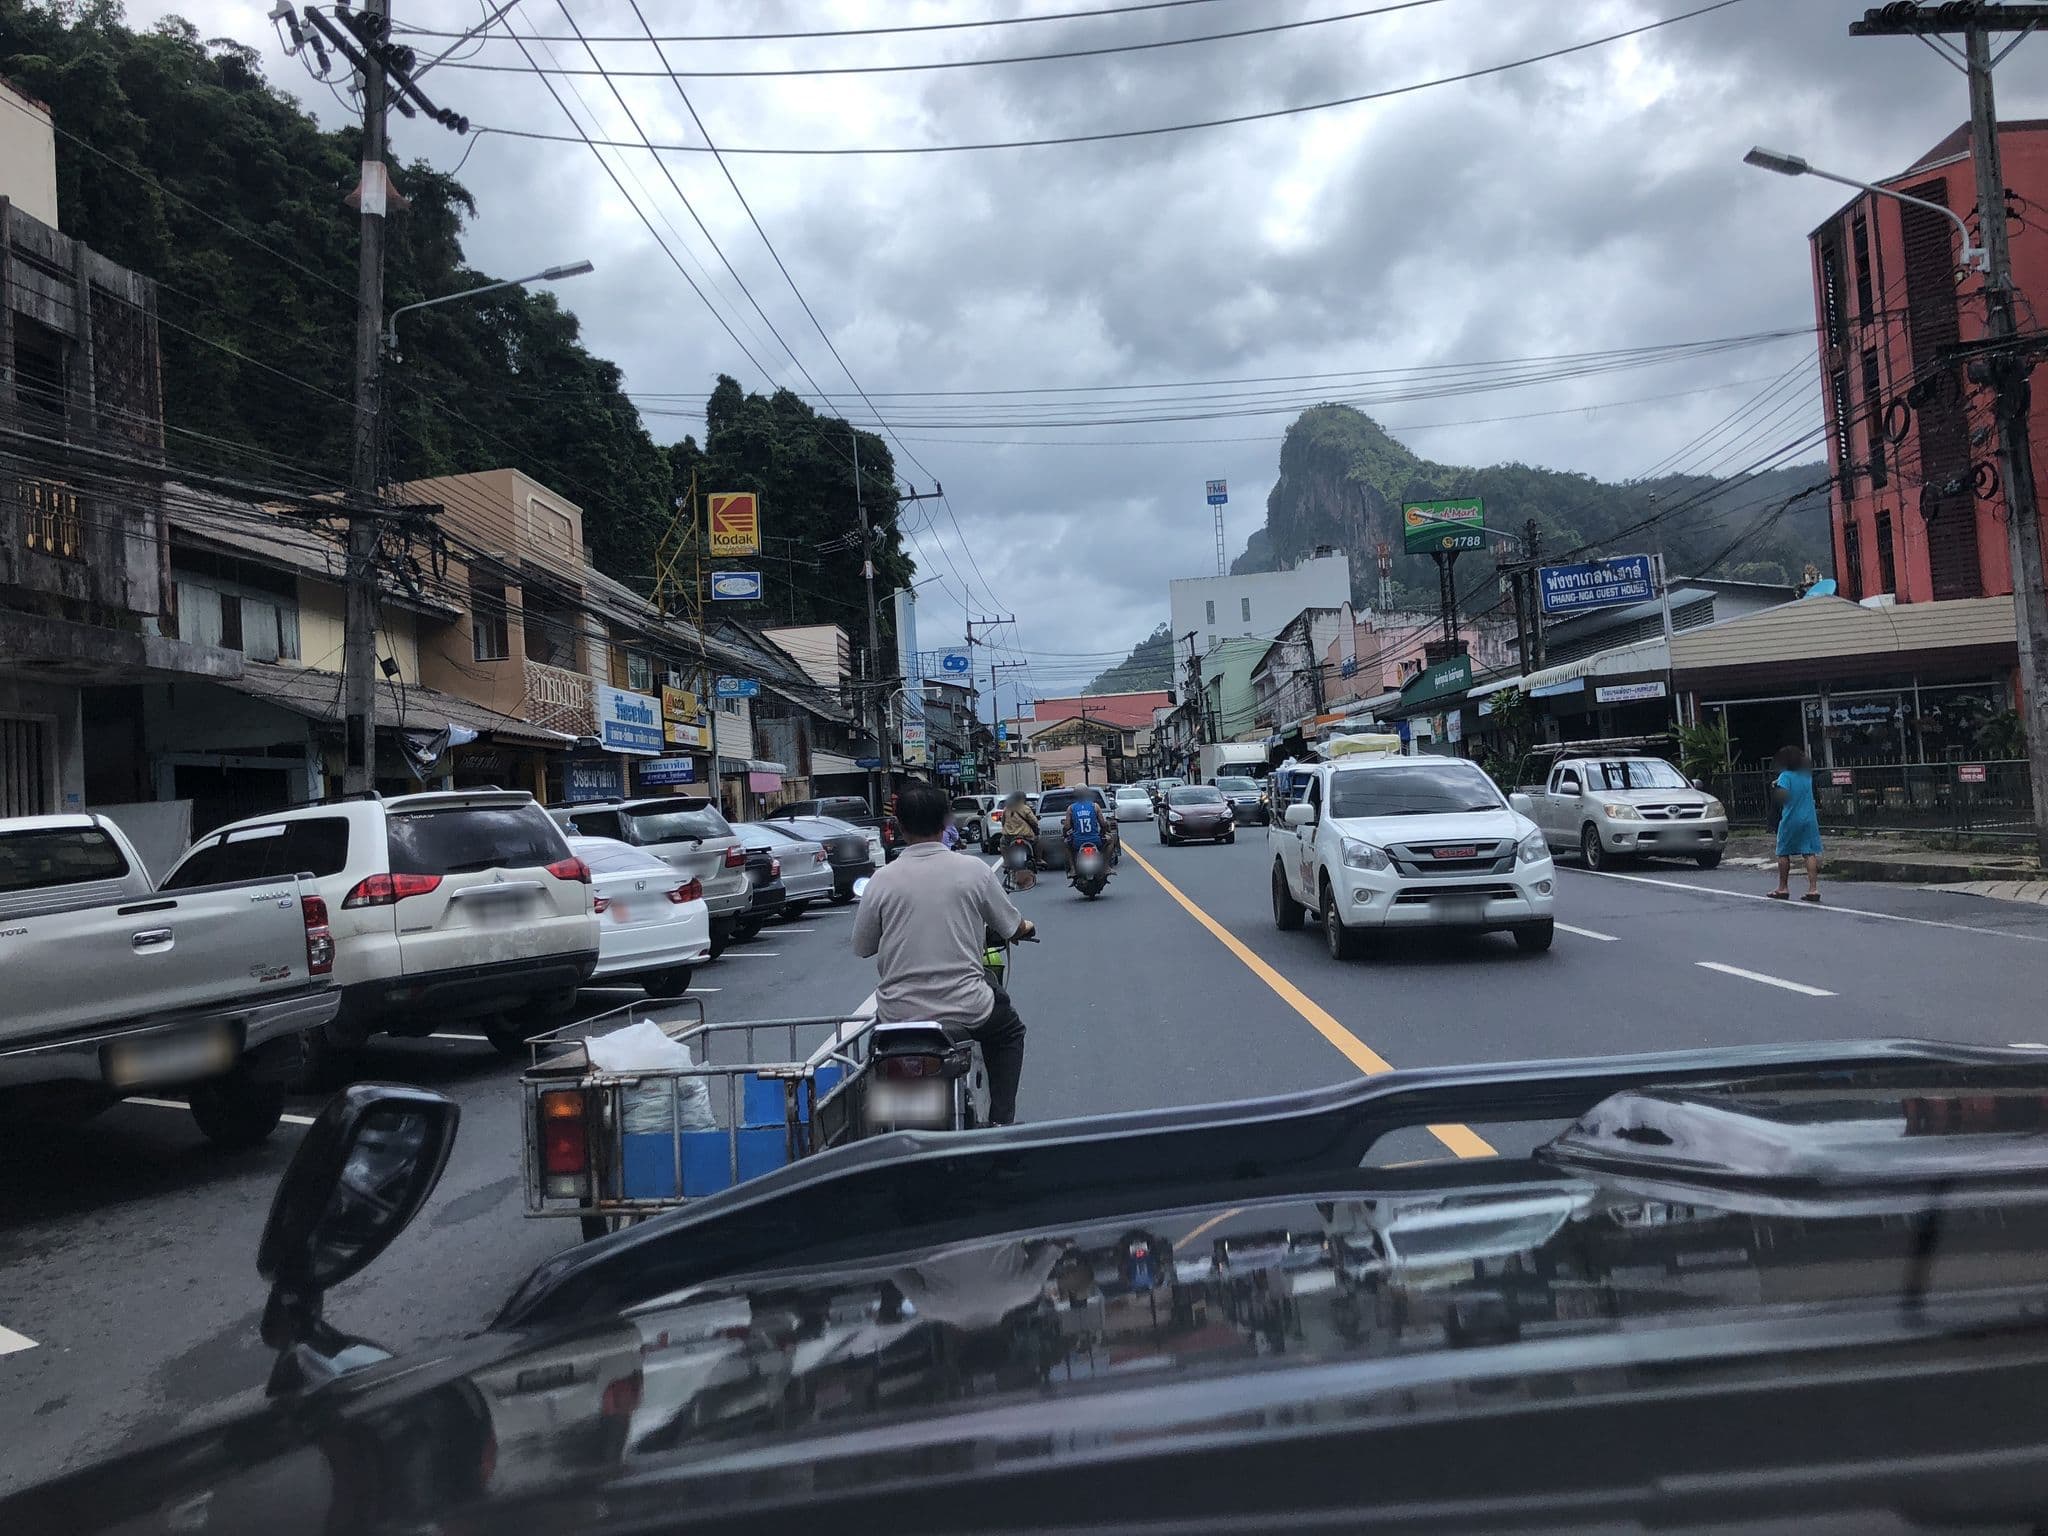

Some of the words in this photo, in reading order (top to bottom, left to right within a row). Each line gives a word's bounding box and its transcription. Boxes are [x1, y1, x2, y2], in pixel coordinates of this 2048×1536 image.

[1207, 484, 1226, 495] TMB
[1452, 506, 1478, 518] Mart
[713, 534, 753, 545] Kodak
[1454, 536, 1480, 547] 1788
[1551, 592, 1594, 605] PHANG-NGA
[1597, 587, 1618, 599] GUEST
[1621, 582, 1645, 595] HOUSE
[1079, 818, 1092, 833] 13
